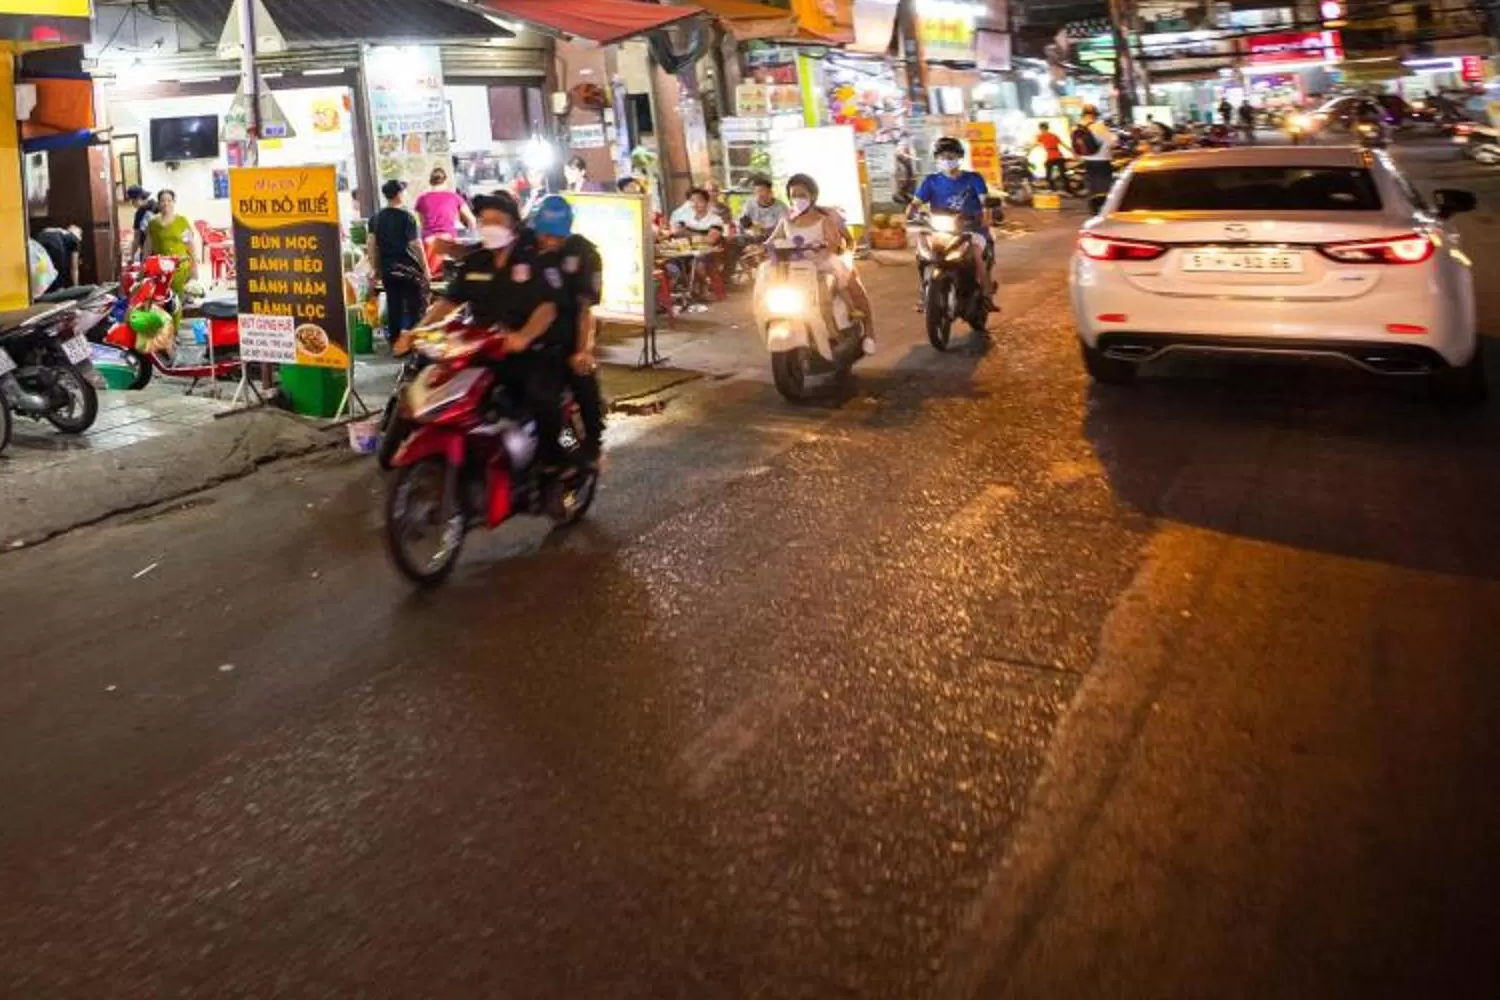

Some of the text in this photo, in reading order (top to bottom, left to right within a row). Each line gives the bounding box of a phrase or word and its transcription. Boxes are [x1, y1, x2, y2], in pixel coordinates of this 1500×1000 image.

[240, 190, 329, 214] BÚN BÒ HUẾ
[251, 232, 280, 249] BÚN
[248, 256, 289, 272] BÁNH
[248, 276, 289, 293] BÁNH
[252, 299, 325, 320] BÁNH LỌC
